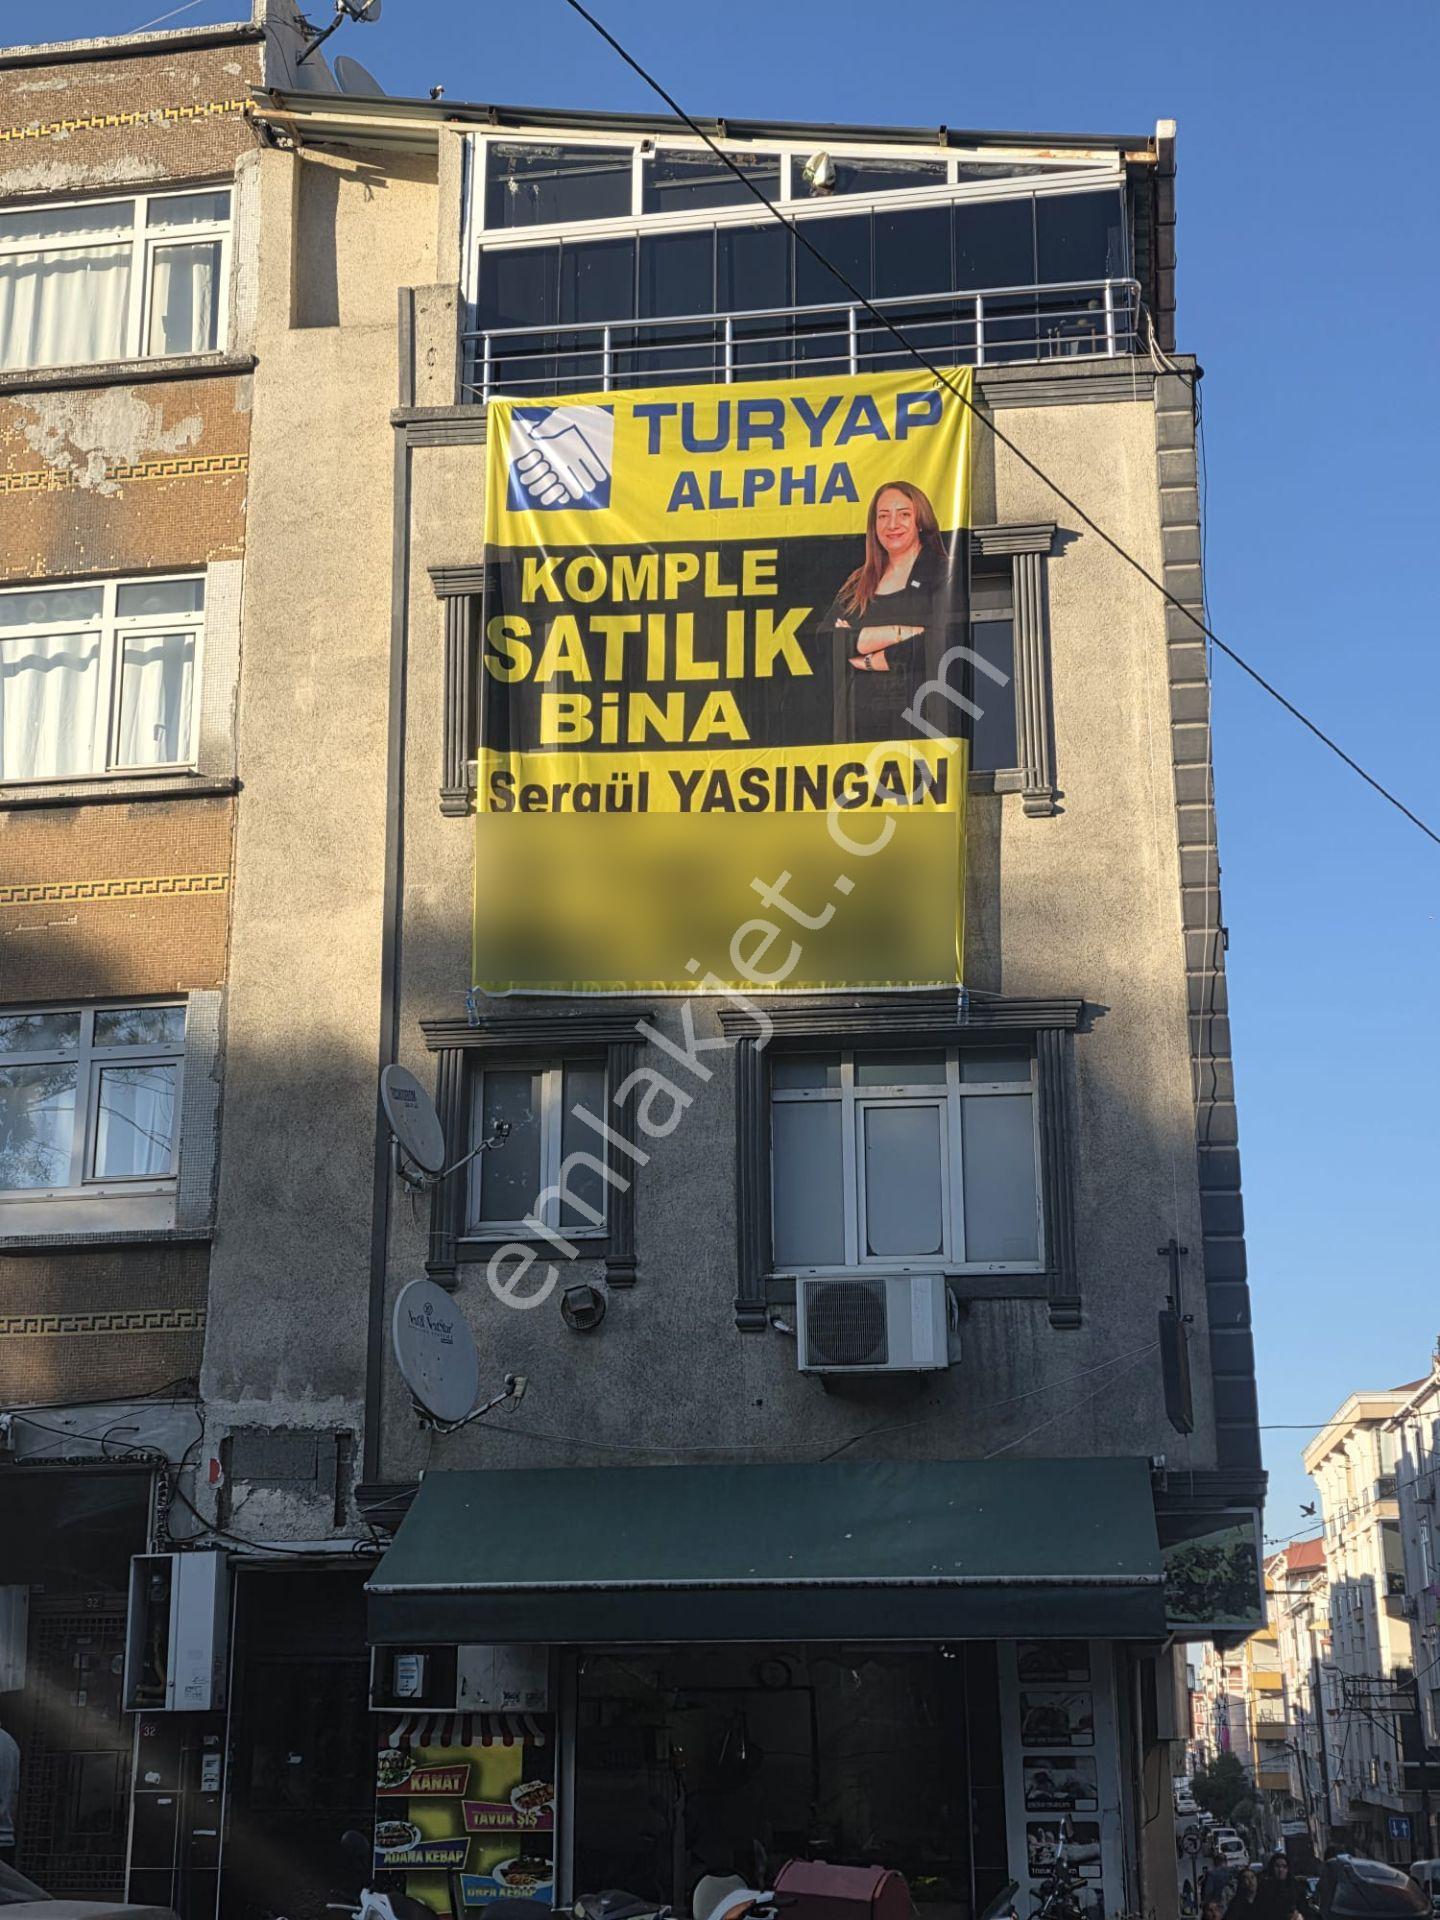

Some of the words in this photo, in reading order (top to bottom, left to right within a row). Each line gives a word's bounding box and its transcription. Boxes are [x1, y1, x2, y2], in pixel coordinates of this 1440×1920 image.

[633, 391, 943, 455] TURYAP
[666, 461, 860, 513] ALPHA
[521, 549, 778, 604] KOMPLE
[483, 606, 815, 684] SATILIK
[668, 757, 949, 813] YASINGAN
[143, 1726, 156, 1737] 32
[410, 1773, 464, 1791] KANAT
[472, 1811, 515, 1825] TAVUK
[384, 1850, 424, 1864] ADANA
[424, 1849, 465, 1863] KEBAP
